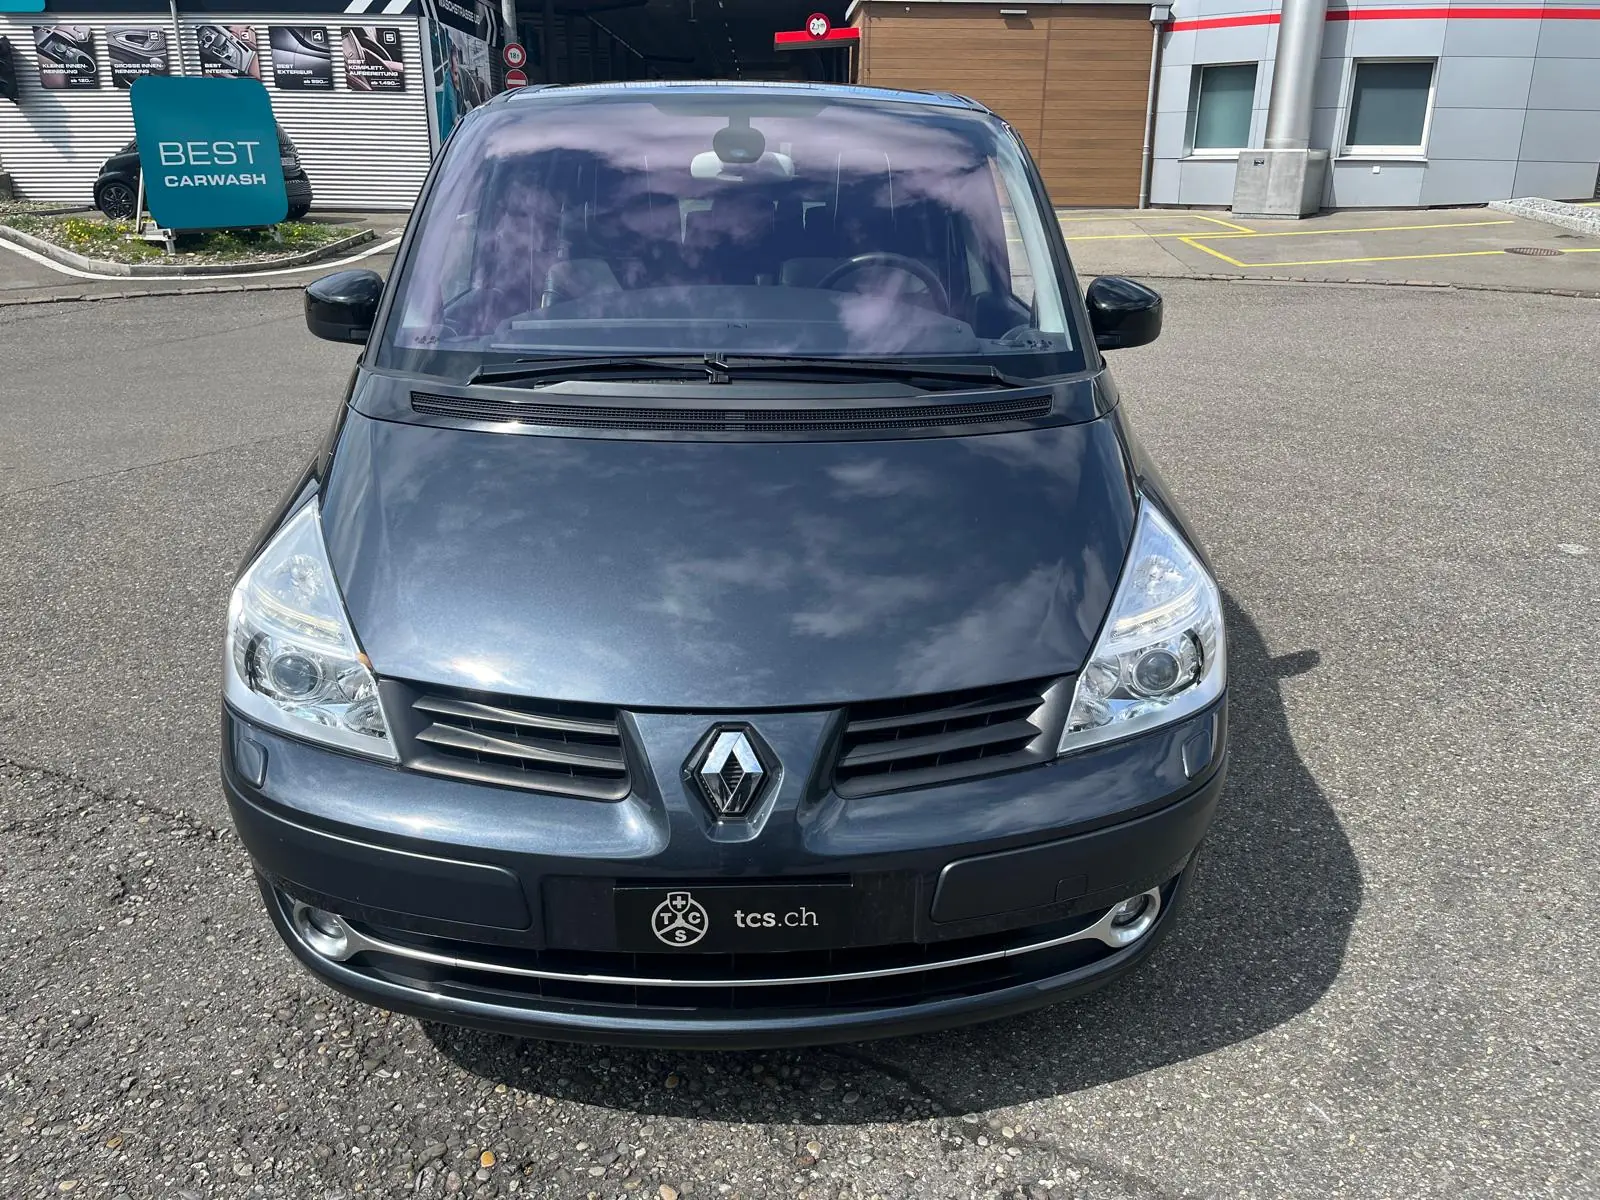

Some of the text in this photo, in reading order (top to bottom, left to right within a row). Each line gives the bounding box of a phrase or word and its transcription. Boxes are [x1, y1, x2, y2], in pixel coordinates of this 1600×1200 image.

[149, 32, 158, 40] 2
[241, 32, 249, 40] 3
[313, 32, 322, 41] 4
[385, 33, 394, 42] 5
[158, 141, 260, 166] BEST
[164, 174, 267, 187] CARWASH
[734, 907, 819, 928] tcs.ch
